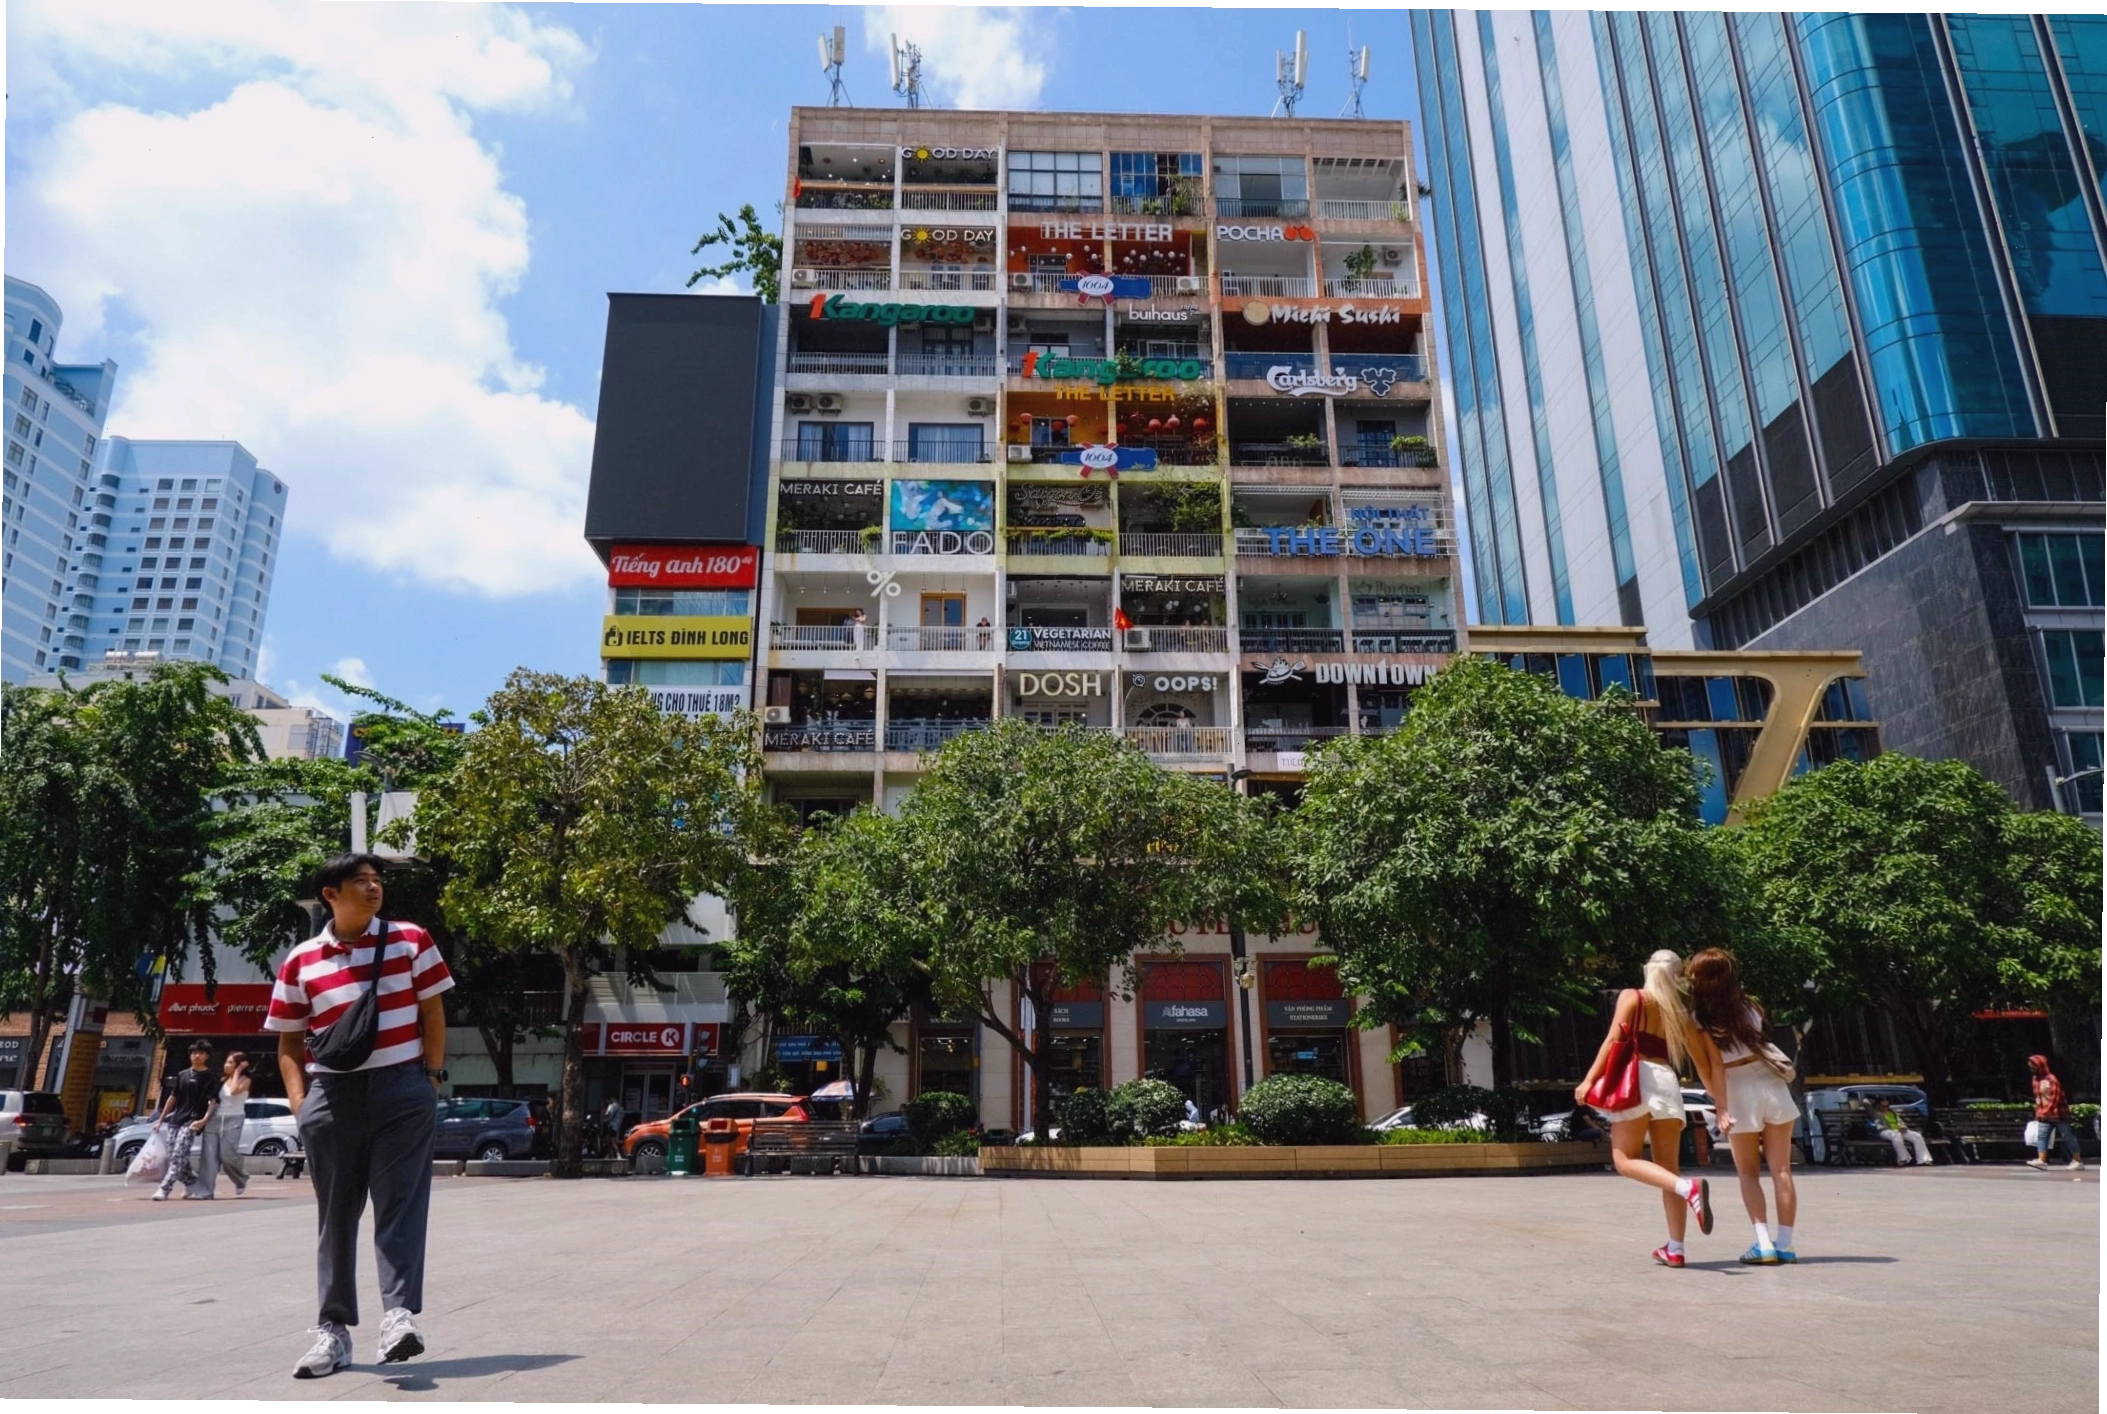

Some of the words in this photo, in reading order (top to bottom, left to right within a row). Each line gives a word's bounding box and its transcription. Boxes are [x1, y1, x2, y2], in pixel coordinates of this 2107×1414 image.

[962, 148, 996, 160] DAY
[964, 230, 994, 242] DAY
[1041, 221, 1082, 239] THE
[1091, 223, 1173, 241] LETTER
[1216, 225, 1284, 241] POCHA
[1081, 278, 1109, 290] 1664
[1271, 304, 1331, 325] Michi
[1338, 305, 1400, 325] Sushi
[1021, 351, 1202, 386] Kangroo
[1267, 366, 1357, 397] Carlsberg
[1055, 384, 1092, 400] THE
[1100, 385, 1176, 401] LETTER
[1083, 452, 1113, 463] 1664
[780, 482, 839, 495] MERAKI
[844, 480, 882, 495] CAFÉ
[1350, 504, 1379, 522] NỘI
[1387, 503, 1430, 520] THẤT
[892, 531, 994, 554] FADO
[1262, 527, 1340, 555] THE
[1354, 528, 1437, 555] ONE
[612, 553, 660, 578] Tiếng
[665, 557, 704, 574] anh
[1121, 580, 1181, 592] MERAKI
[1185, 578, 1224, 593] CAFÉ
[626, 631, 666, 645] IELTS
[671, 628, 706, 645] ĐÌNH
[711, 631, 749, 645] LONG
[1014, 630, 1028, 640] 21
[1033, 629, 1111, 639] VEGETARIAN
[1033, 640, 1079, 649] VIETNAMESE
[1082, 641, 1110, 649] COFFEE
[1020, 672, 1101, 697] DOSH
[1154, 676, 1218, 692] OOPS!
[665, 692, 685, 712] CHO
[688, 690, 711, 712] THUÊ
[764, 731, 830, 746] MERAKI
[833, 730, 875, 746] CAFÉ
[227, 1004, 254, 1013] pierre
[256, 1004, 270, 1012] car
[1171, 1005, 1209, 1017] fahasa
[611, 1031, 657, 1044] CIRCLE
[662, 1029, 679, 1045] K
